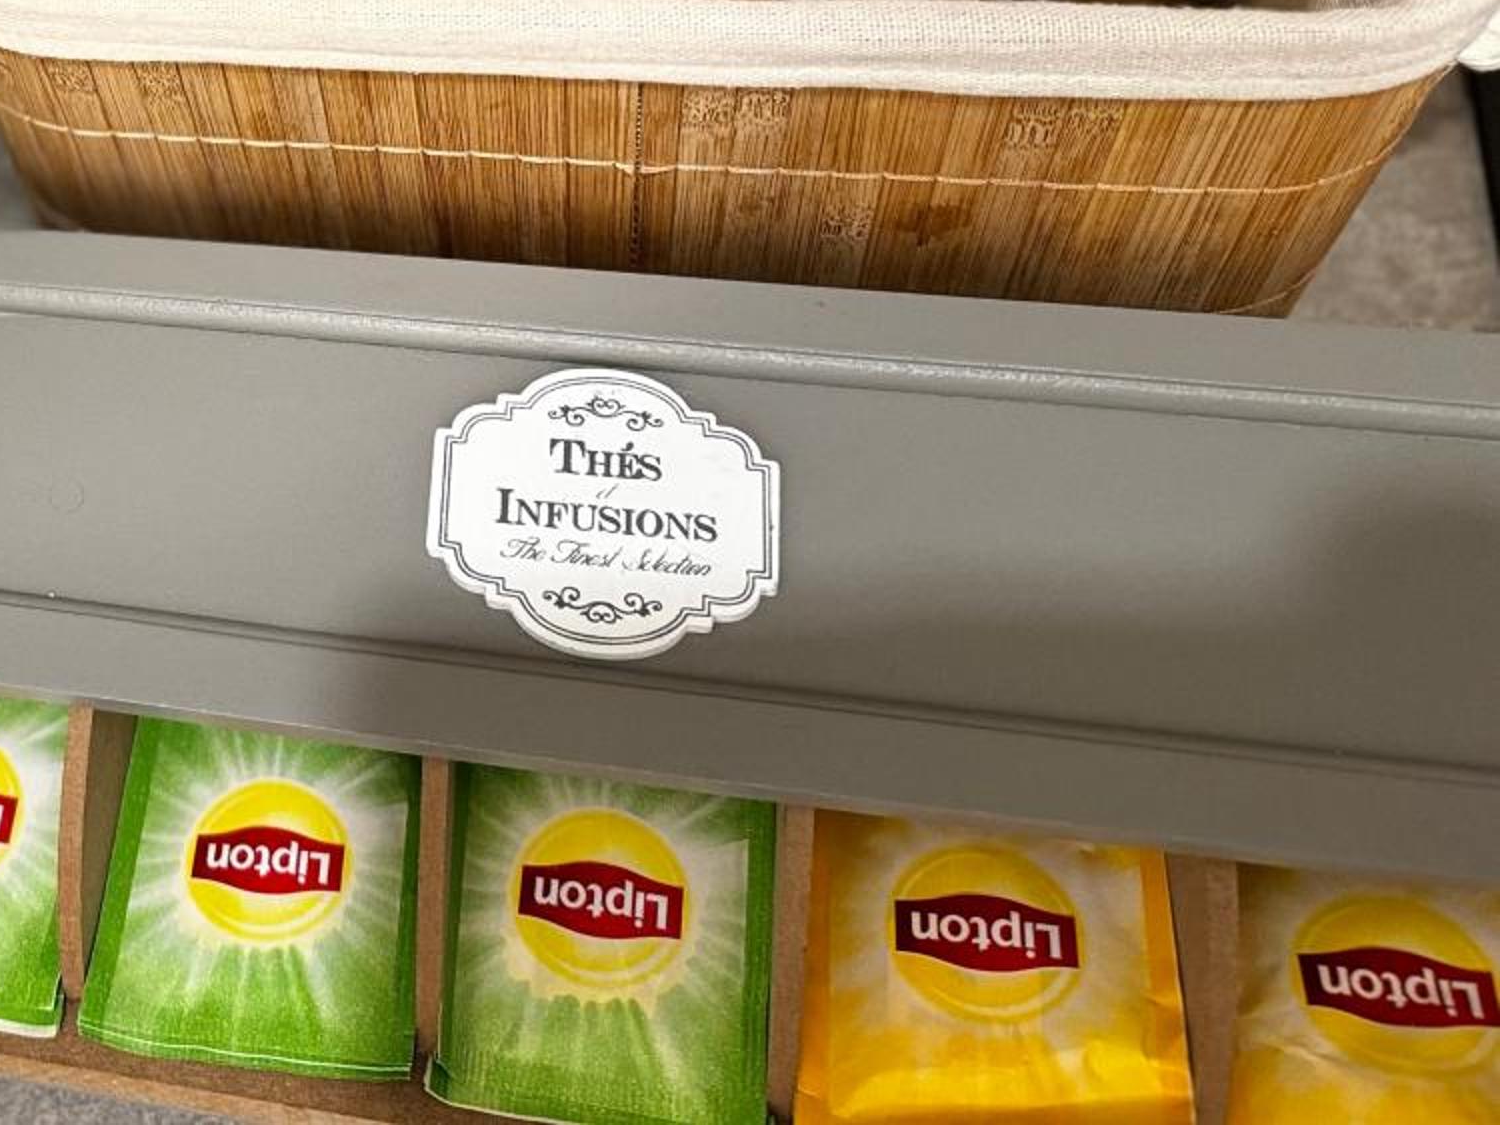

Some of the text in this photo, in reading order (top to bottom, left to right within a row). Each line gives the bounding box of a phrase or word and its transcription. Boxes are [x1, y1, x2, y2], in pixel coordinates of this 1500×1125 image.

[495, 487, 718, 543] INFUSIONS
[500, 536, 712, 577] The Finest Selection
[206, 841, 332, 886] Lipton
[533, 875, 670, 931] Lipton
[911, 909, 1062, 960] Lipton
[1317, 963, 1485, 1019] Lipton
